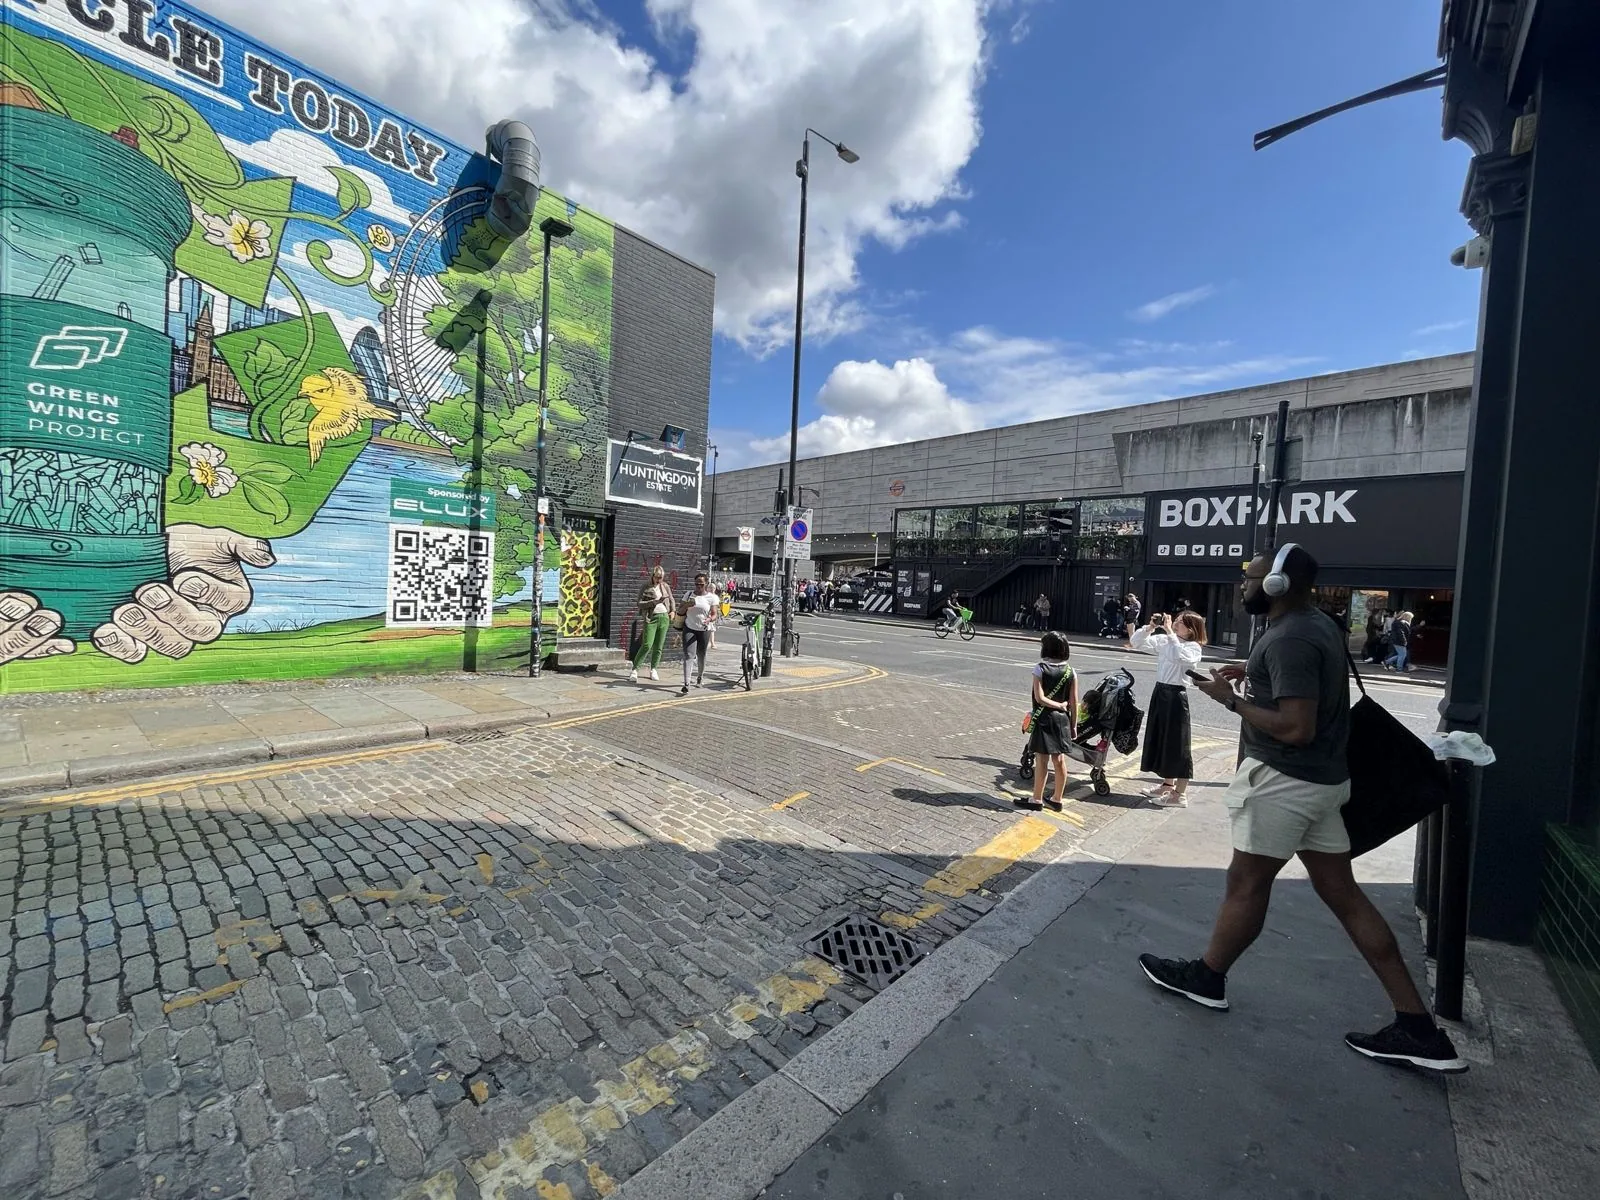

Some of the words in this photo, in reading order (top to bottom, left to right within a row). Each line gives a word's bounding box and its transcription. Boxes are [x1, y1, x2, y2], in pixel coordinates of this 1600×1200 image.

[25, 0, 222, 86] CLE
[246, 54, 444, 184] TODAY
[27, 382, 119, 408] GREEN
[27, 400, 120, 425] WINGS
[29, 418, 145, 445] PROJECT
[620, 463, 696, 488] HUNTINGDON
[646, 481, 672, 493] ESTATE
[394, 498, 488, 519] ELUX
[427, 488, 477, 500] Sponsored
[479, 493, 490, 504] by
[1159, 489, 1358, 527] BOXPARK
[589, 520, 597, 530] 5
